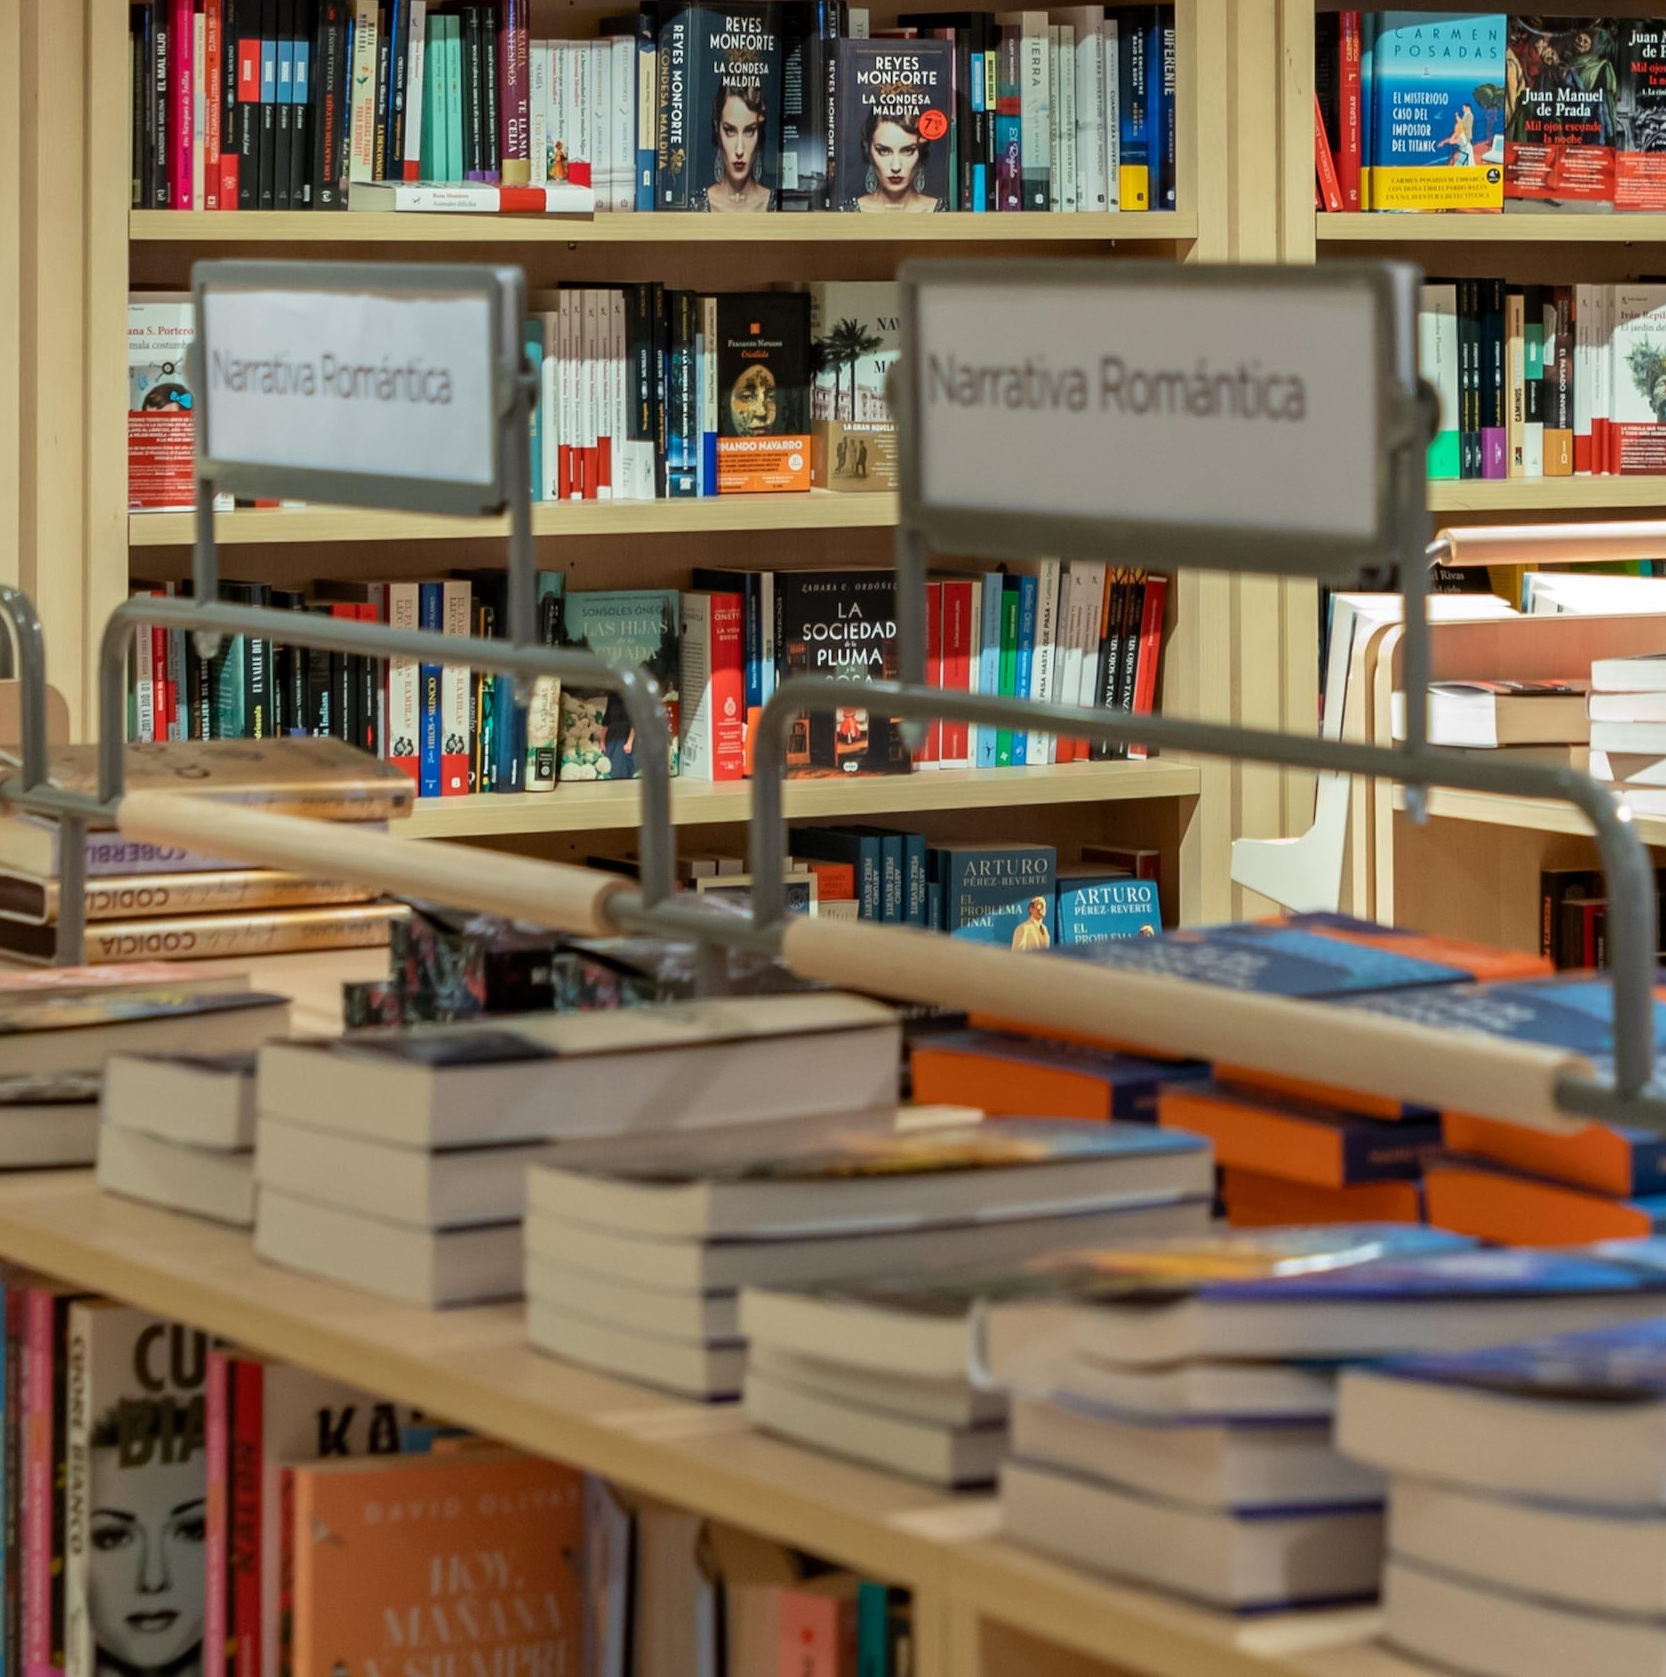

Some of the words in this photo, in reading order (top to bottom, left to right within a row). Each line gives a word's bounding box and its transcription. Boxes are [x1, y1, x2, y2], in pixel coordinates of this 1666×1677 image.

[725, 16, 762, 33] REYES
[1395, 28, 1497, 41] CARMEN
[1629, 29, 1659, 46] Juan
[157, 33, 167, 55] HIJO
[672, 24, 684, 65] REYES
[710, 34, 774, 51] MONFORTE
[1395, 45, 1497, 59] POSADAS
[1642, 44, 1657, 58] de
[876, 57, 919, 70] REYES
[1031, 32, 1040, 87] TIERRA
[157, 57, 167, 78] MAL
[713, 61, 725, 73] LA
[728, 61, 769, 75] CONDESA
[1630, 62, 1647, 72] Mil
[1649, 63, 1666, 74] ojos
[722, 75, 761, 88] MALDITA
[857, 71, 937, 85] MONFORTE
[1649, 76, 1658, 85] la
[157, 80, 166, 91] EL
[862, 94, 876, 105] LA
[879, 94, 930, 106] CONDESA
[1393, 92, 1401, 104] EL
[1404, 92, 1449, 105] MISTERIOSO
[1522, 87, 1554, 105] Juan
[1557, 88, 1603, 102] Manuel
[670, 69, 683, 144] MONFORTE
[873, 105, 920, 116] MALDITA
[1536, 103, 1552, 117] de
[1555, 103, 1591, 117] Prada
[1392, 108, 1413, 120] CASO
[1414, 108, 1428, 120] DEL
[1392, 124, 1432, 136] IMPOSTOR
[1525, 121, 1541, 131] Mil
[1544, 122, 1563, 133] ojos
[1565, 122, 1602, 132] esconde
[508, 119, 517, 152] CELIA
[1543, 134, 1554, 144] la
[1556, 135, 1582, 144] noche
[1392, 139, 1405, 152] DEL
[1408, 140, 1436, 152] TITANIC
[212, 349, 317, 398] Narrativa
[321, 350, 454, 405] Romántica
[929, 353, 1090, 411] Narrativa
[1099, 355, 1308, 422] Romántica
[759, 441, 802, 451] NAVARRO
[837, 602, 863, 618] LA
[802, 622, 897, 641] SOCIEDAD
[816, 648, 883, 666] PLUMA
[964, 858, 1049, 877] ARTURO
[960, 894, 973, 905] EL
[1074, 886, 1152, 906] ARTURO
[960, 904, 1023, 917] PROBLEMA
[960, 916, 995, 928] FINAL
[1073, 923, 1088, 934] EL
[99, 930, 196, 958] CODICIA
